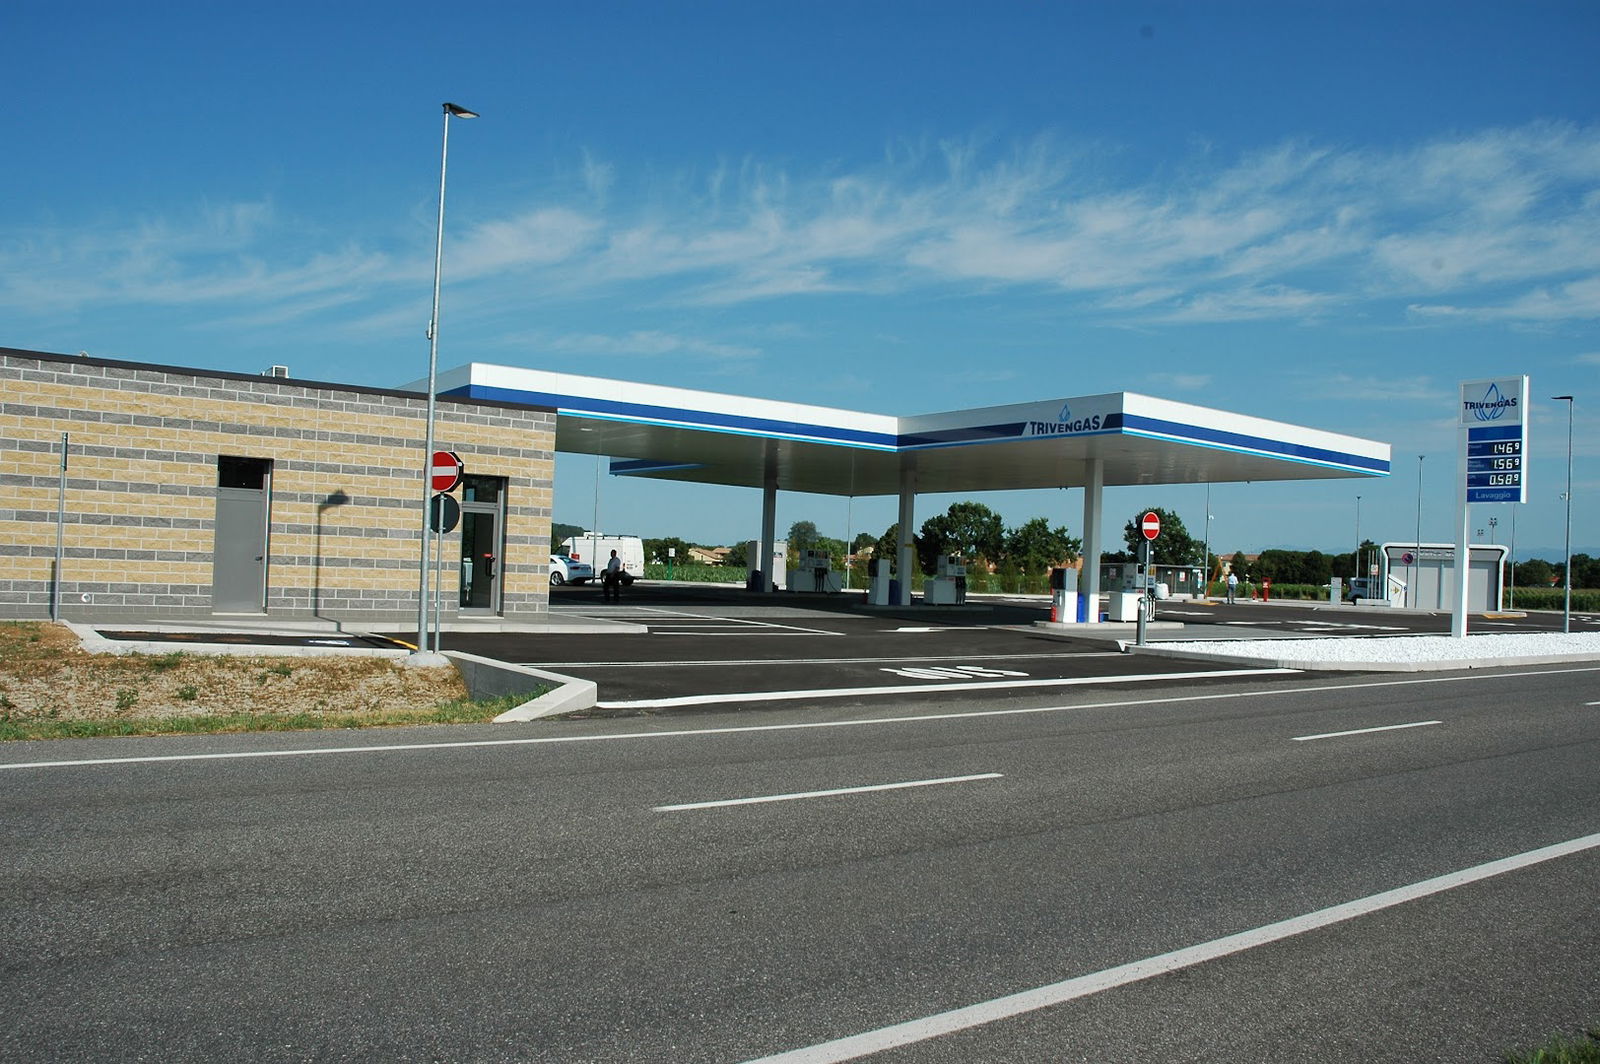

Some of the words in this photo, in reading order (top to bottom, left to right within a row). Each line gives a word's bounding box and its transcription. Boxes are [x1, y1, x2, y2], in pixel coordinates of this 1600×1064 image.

[1463, 397, 1517, 410] TRIVENGAS
[1030, 415, 1100, 435] TRIVENGAS
[1475, 491, 1511, 500] Lavaggio
